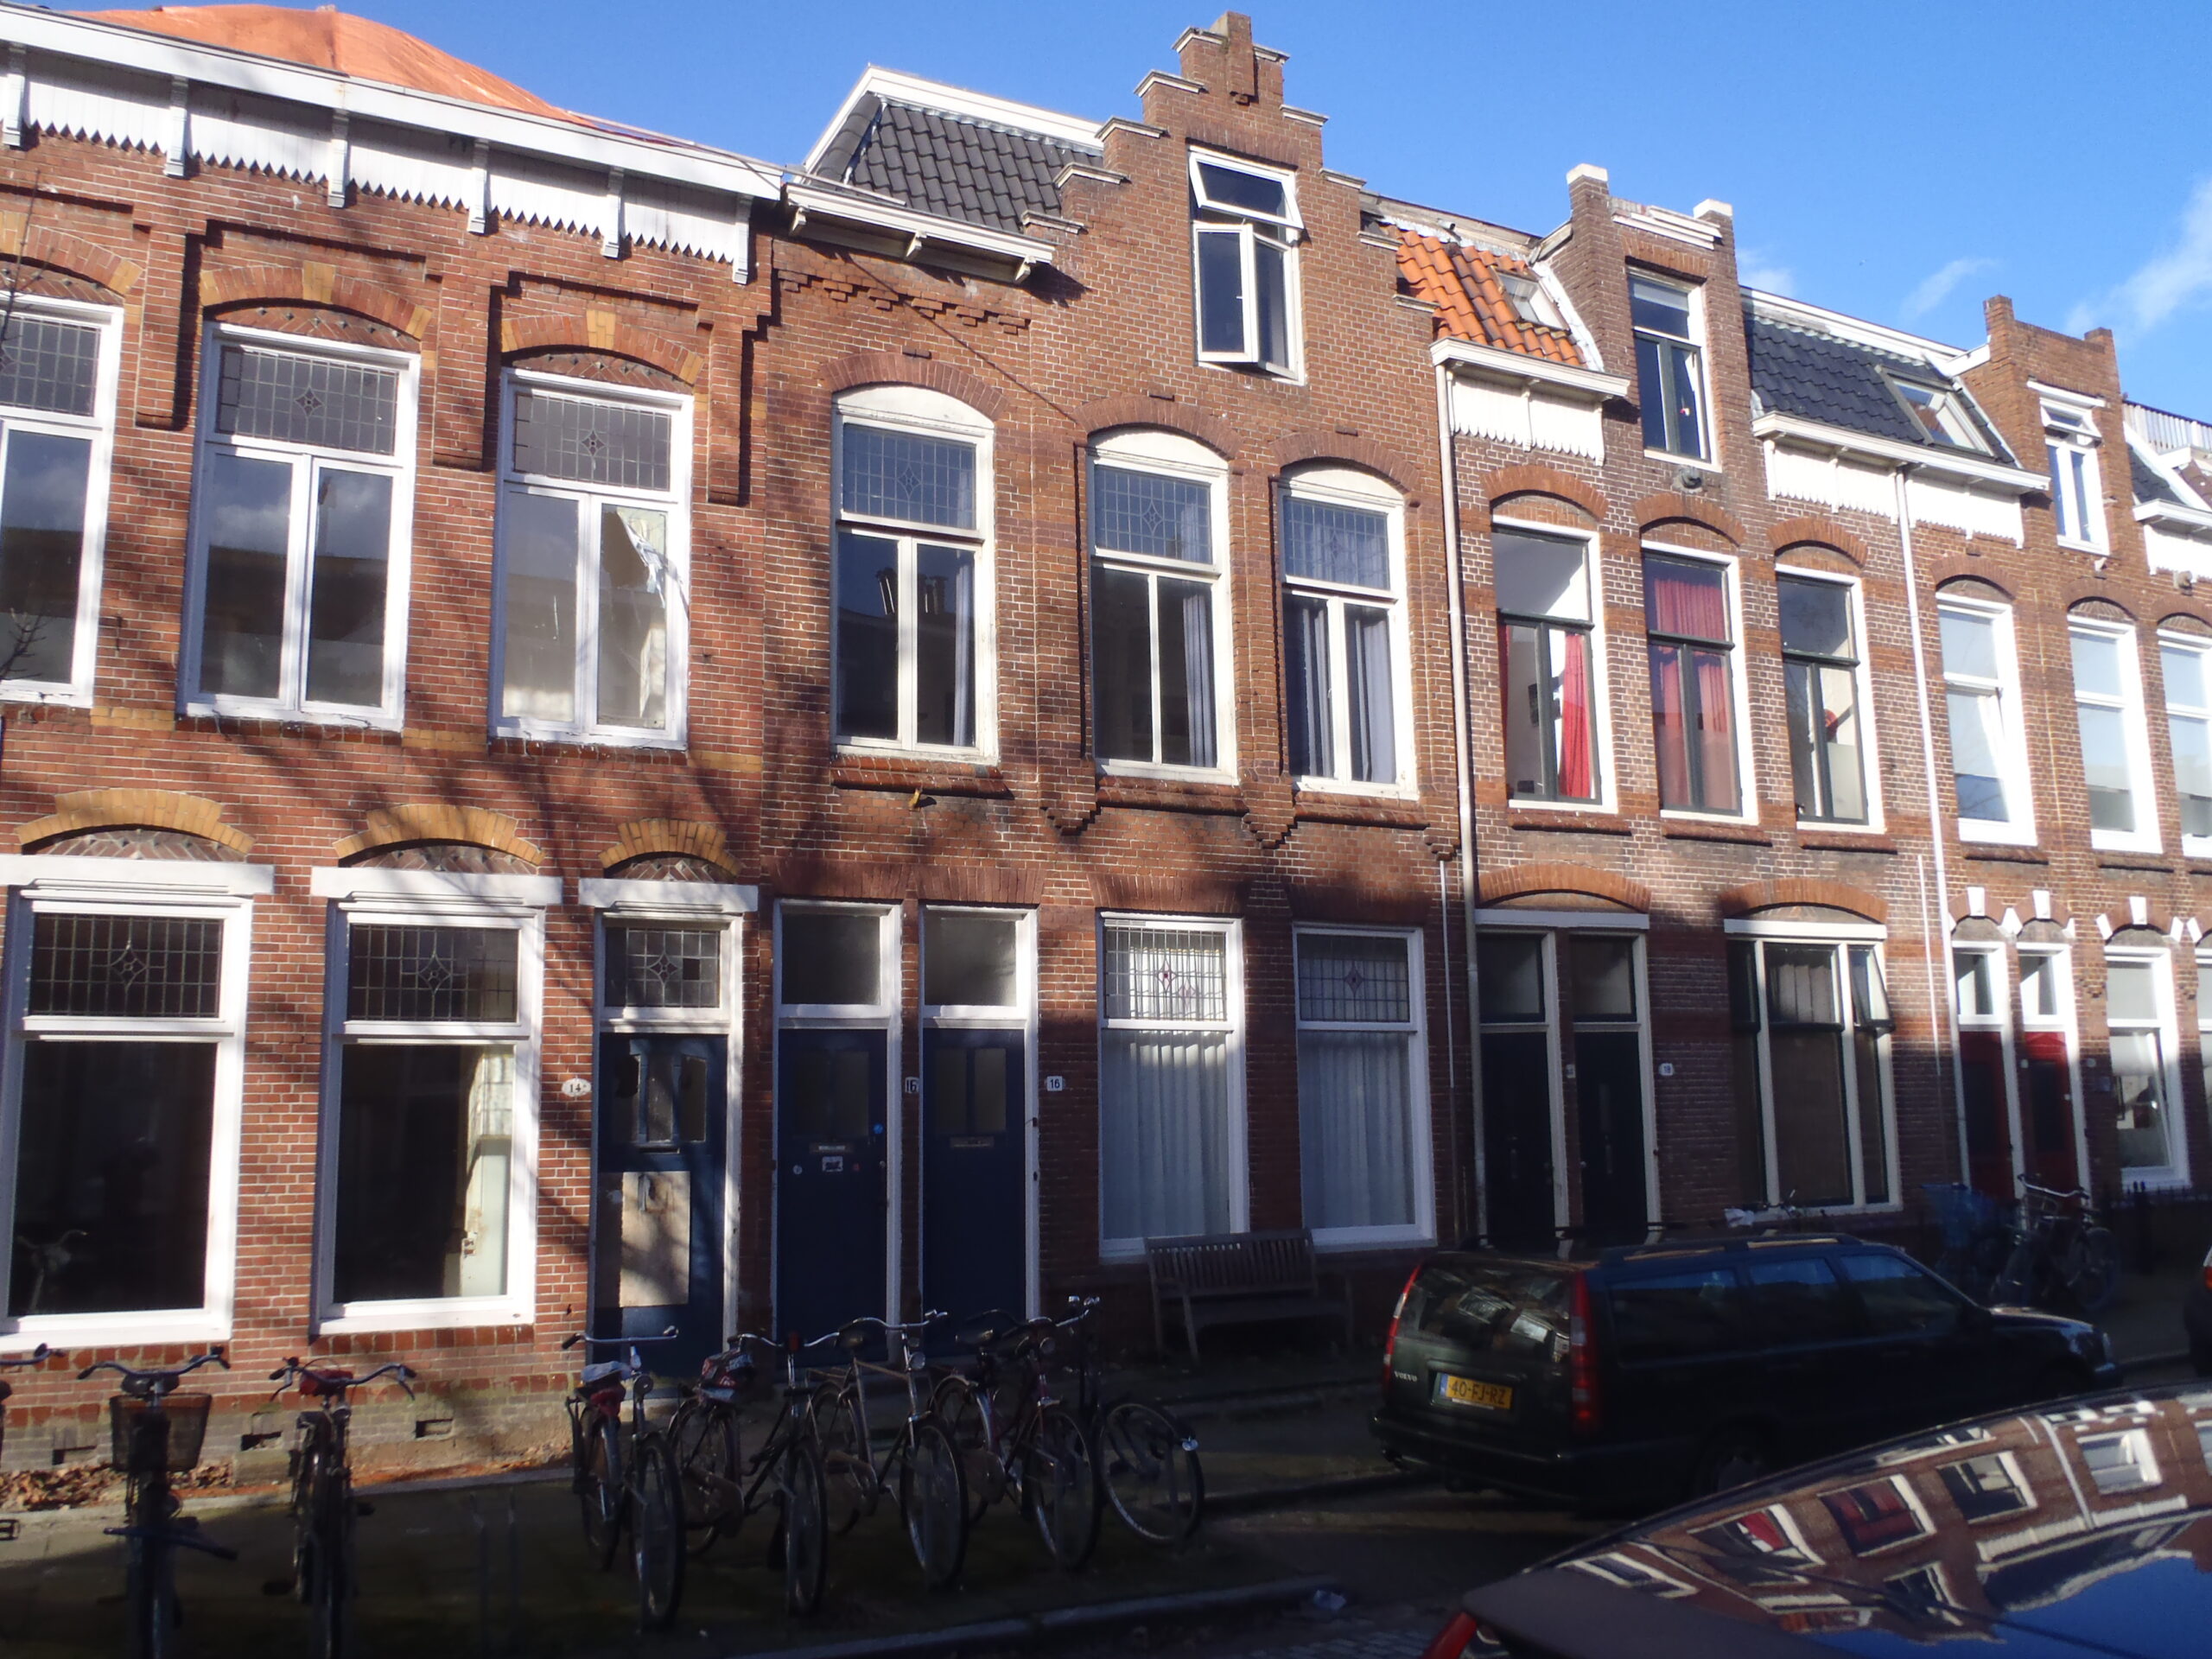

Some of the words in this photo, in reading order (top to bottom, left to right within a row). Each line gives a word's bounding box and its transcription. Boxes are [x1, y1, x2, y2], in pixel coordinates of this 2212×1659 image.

[1050, 1078, 1060, 1089] 16
[1394, 1370, 1418, 1382] VOLVO
[1451, 1380, 1507, 1405] 40-FJ-RZ
